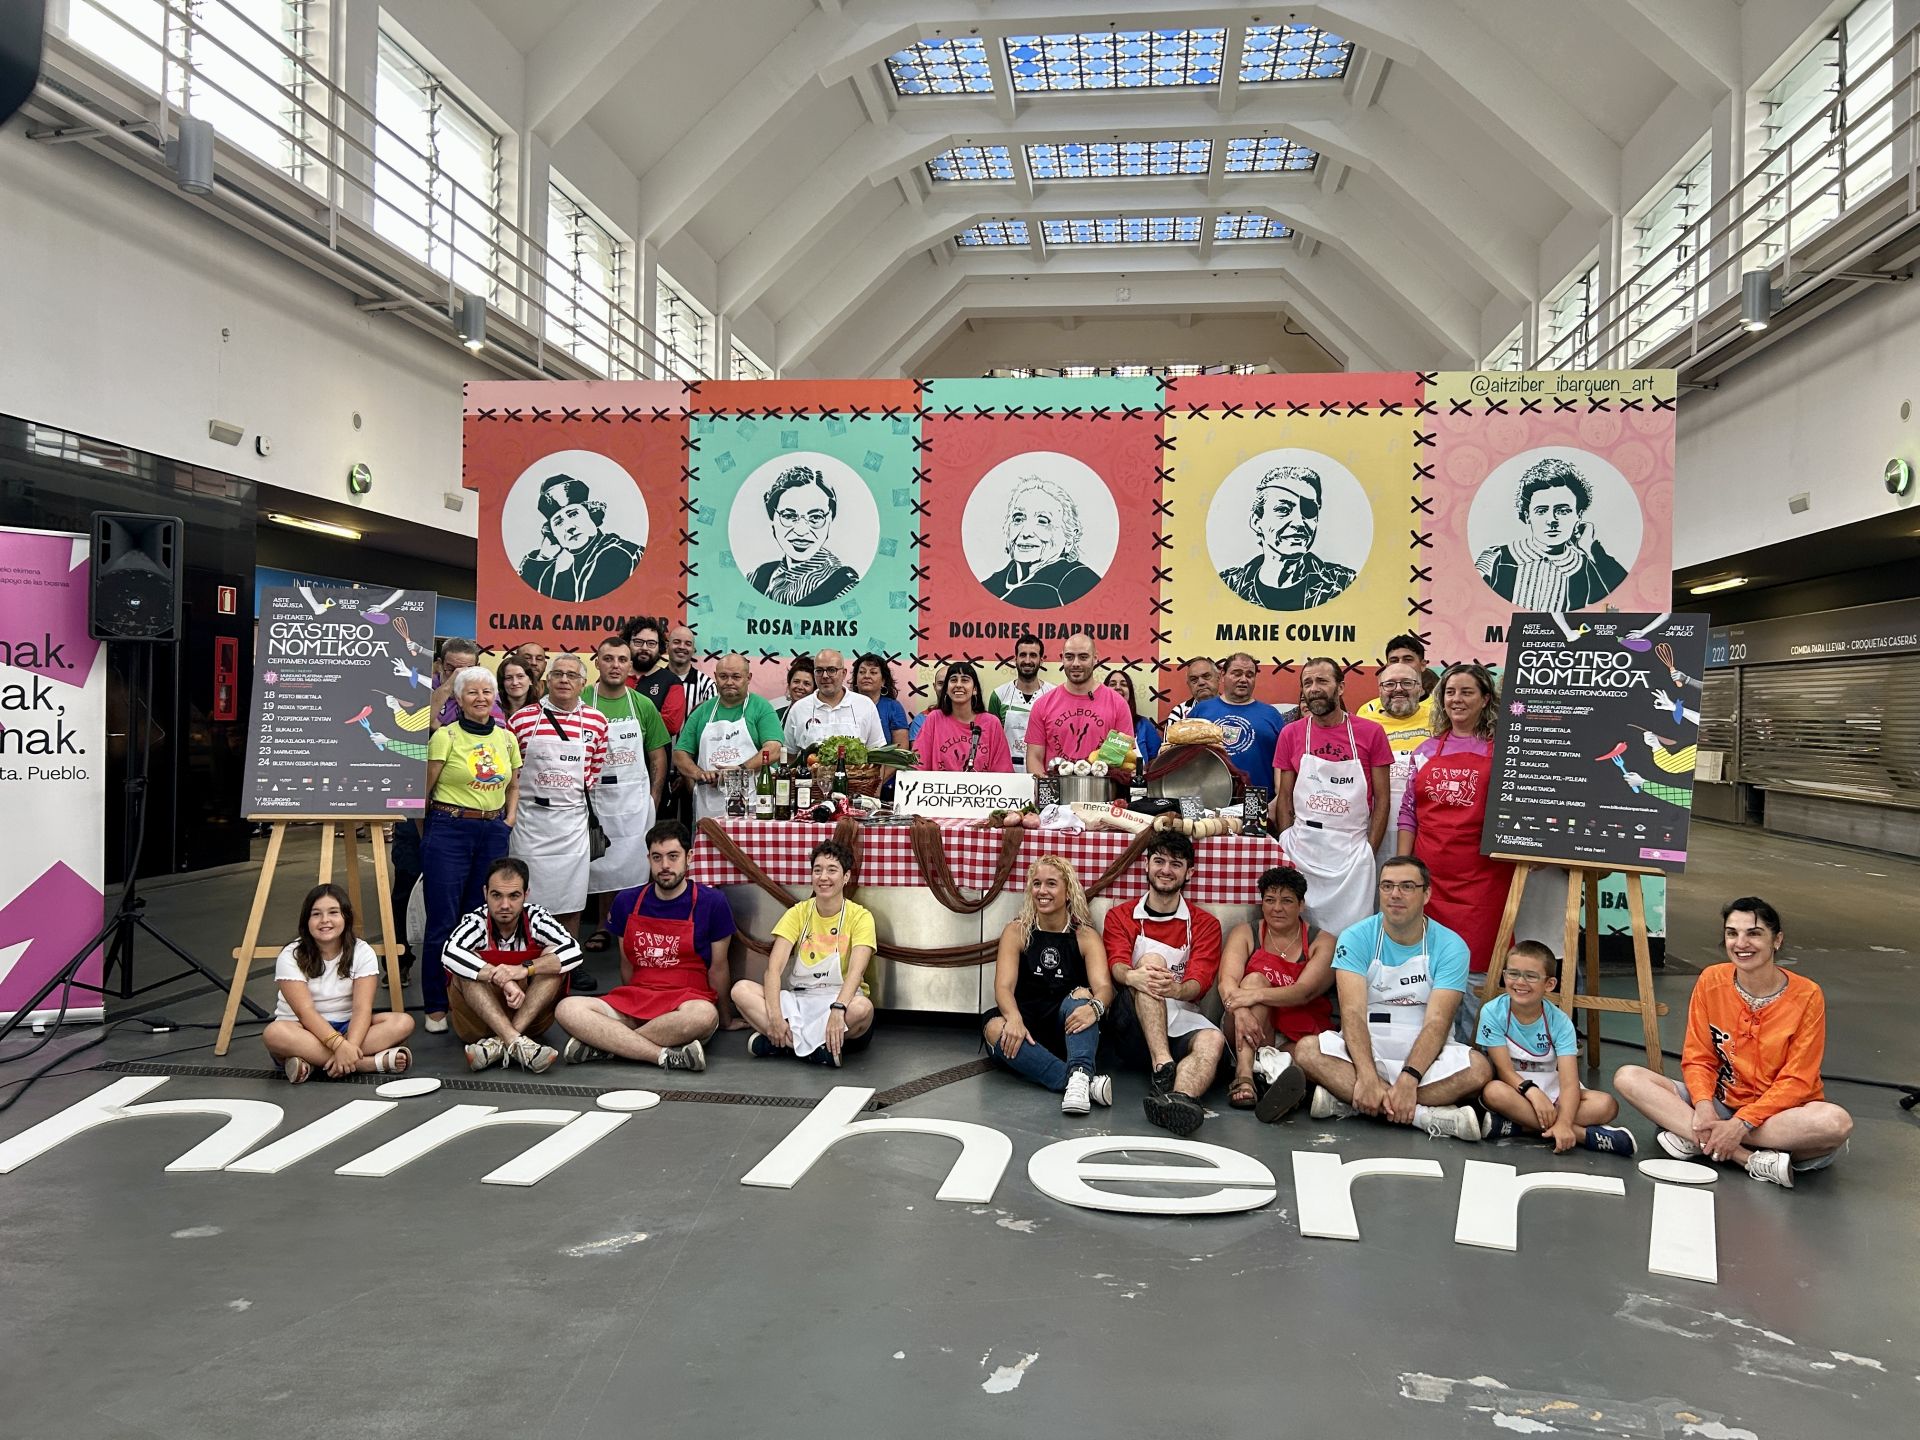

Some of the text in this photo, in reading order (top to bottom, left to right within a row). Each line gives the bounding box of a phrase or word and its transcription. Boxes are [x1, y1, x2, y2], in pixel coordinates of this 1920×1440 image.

[1470, 375, 1654, 396] @aitziber_ibarguen_art
[489, 613, 544, 630] CLARA
[747, 618, 858, 636] ROSA PARKS
[270, 622, 374, 641] GASTRO
[949, 621, 1030, 639] DOLORES
[1215, 624, 1356, 642] MARIE COLVIN
[268, 639, 390, 657] NOMIKOA
[1790, 634, 1917, 656] COMIDA PARA LLEVAR CROQUETAS CASERAS
[1712, 647, 1725, 662] 222
[1729, 644, 1747, 660] 220
[267, 657, 371, 666] CERTAMEN GASTRONÓMICO
[1518, 650, 1632, 669] GASTRO
[1516, 667, 1650, 689] NOMIKOA
[1, 675, 65, 717] ak,
[263, 691, 275, 699] 18
[1515, 687, 1628, 698] CERTAMEN GASTRONÓMICO
[263, 702, 274, 710] 19
[1513, 704, 1523, 712] 17
[261, 713, 274, 721] 20
[1055, 708, 1104, 727] BILBOKO
[261, 724, 273, 732] 21
[1509, 723, 1521, 731] 18
[0, 719, 86, 755] nak.
[260, 736, 273, 744] 22
[1108, 736, 1130, 748] udapa
[1507, 734, 1520, 743] 19
[259, 747, 272, 755] 23
[1506, 746, 1520, 755] 20
[258, 758, 270, 766] 24
[1504, 758, 1517, 766] 21
[28, 766, 90, 781] Pueblo.
[1503, 770, 1517, 778] 22
[1339, 777, 1354, 785] BM
[1502, 781, 1515, 790] 23
[922, 783, 1002, 796] BILBOKO
[917, 795, 1031, 810] KONPARTSAK
[1500, 793, 1513, 802] 24
[1306, 801, 1350, 814] NOMIKOA
[1411, 974, 1427, 984] BM
[0, 1076, 1719, 1284] hiri herri
